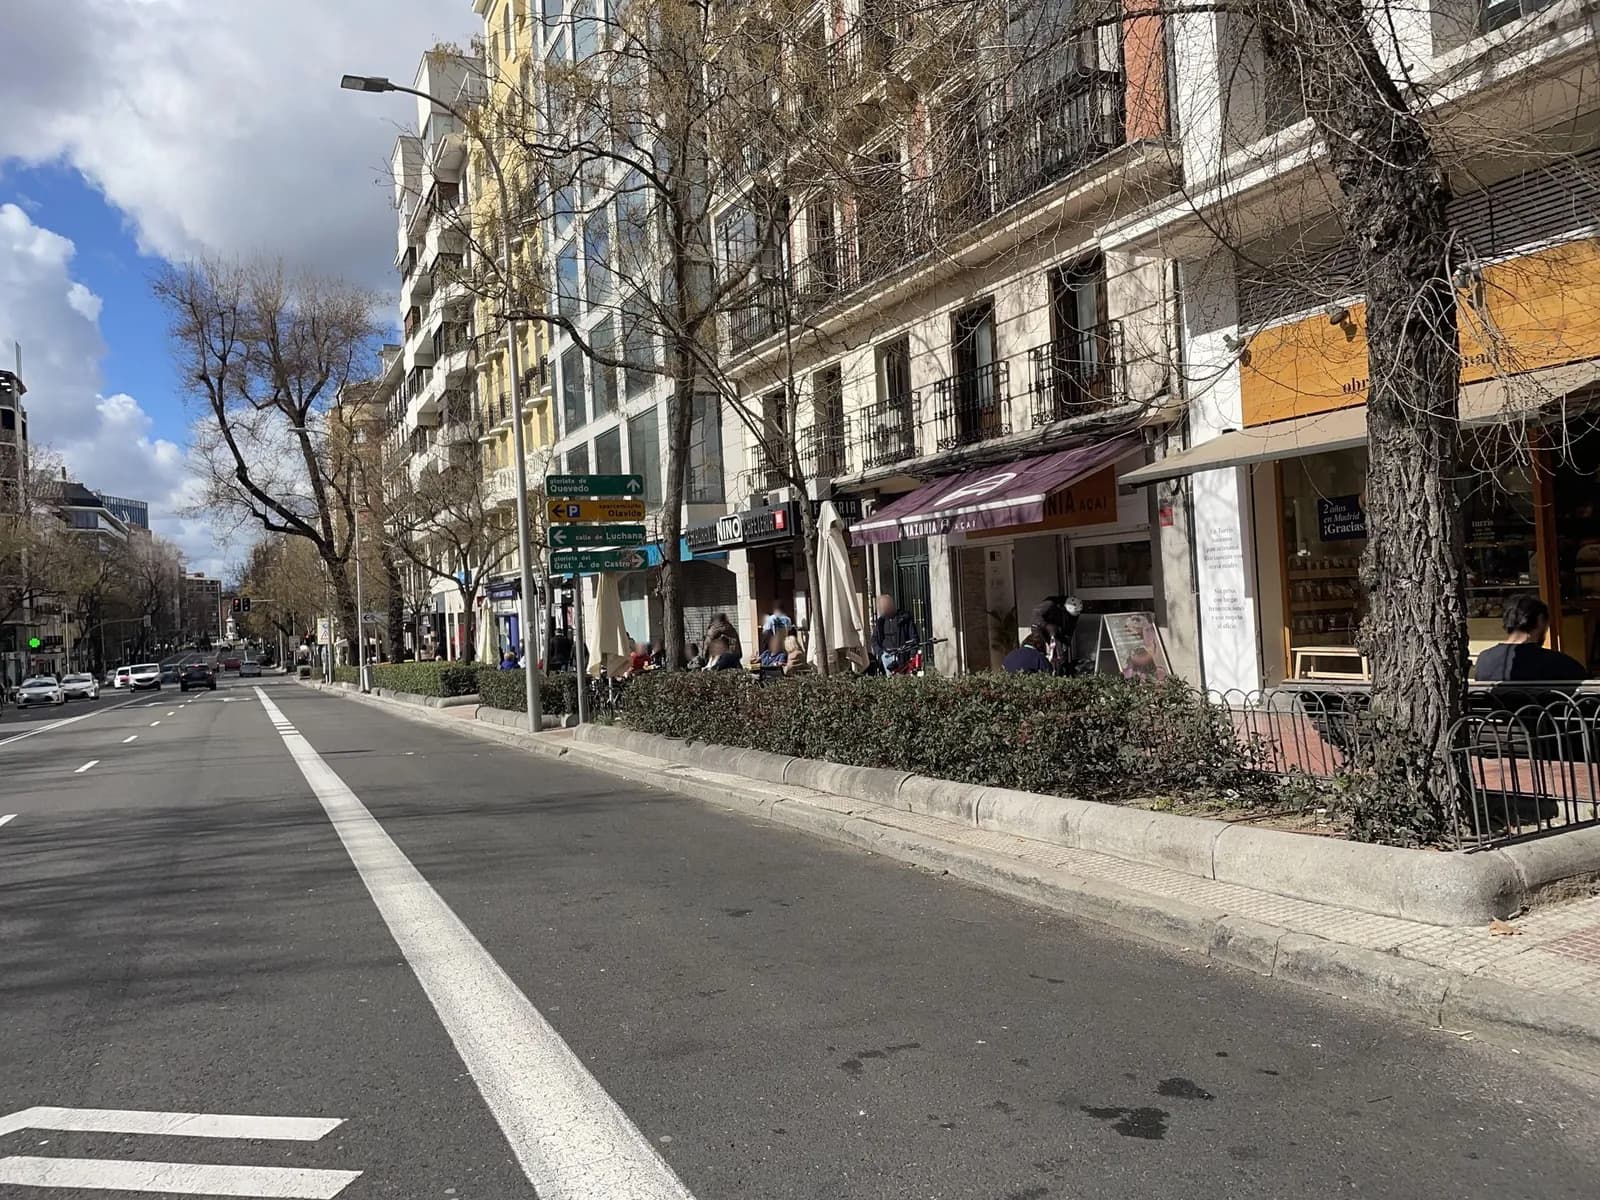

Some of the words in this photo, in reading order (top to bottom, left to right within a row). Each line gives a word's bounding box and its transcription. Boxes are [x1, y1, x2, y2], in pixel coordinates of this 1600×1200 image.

[550, 484, 589, 493] Quevedo
[568, 505, 578, 517] P
[1323, 504, 1329, 514] 2
[1329, 504, 1346, 513] años
[1323, 516, 1332, 524] en
[1334, 511, 1360, 522] Madrid
[716, 517, 741, 541] NINO
[606, 532, 643, 540] Luchana
[554, 561, 574, 569] Gral.
[578, 561, 587, 569] A.
[590, 560, 600, 568] de
[604, 559, 631, 568] Castro
